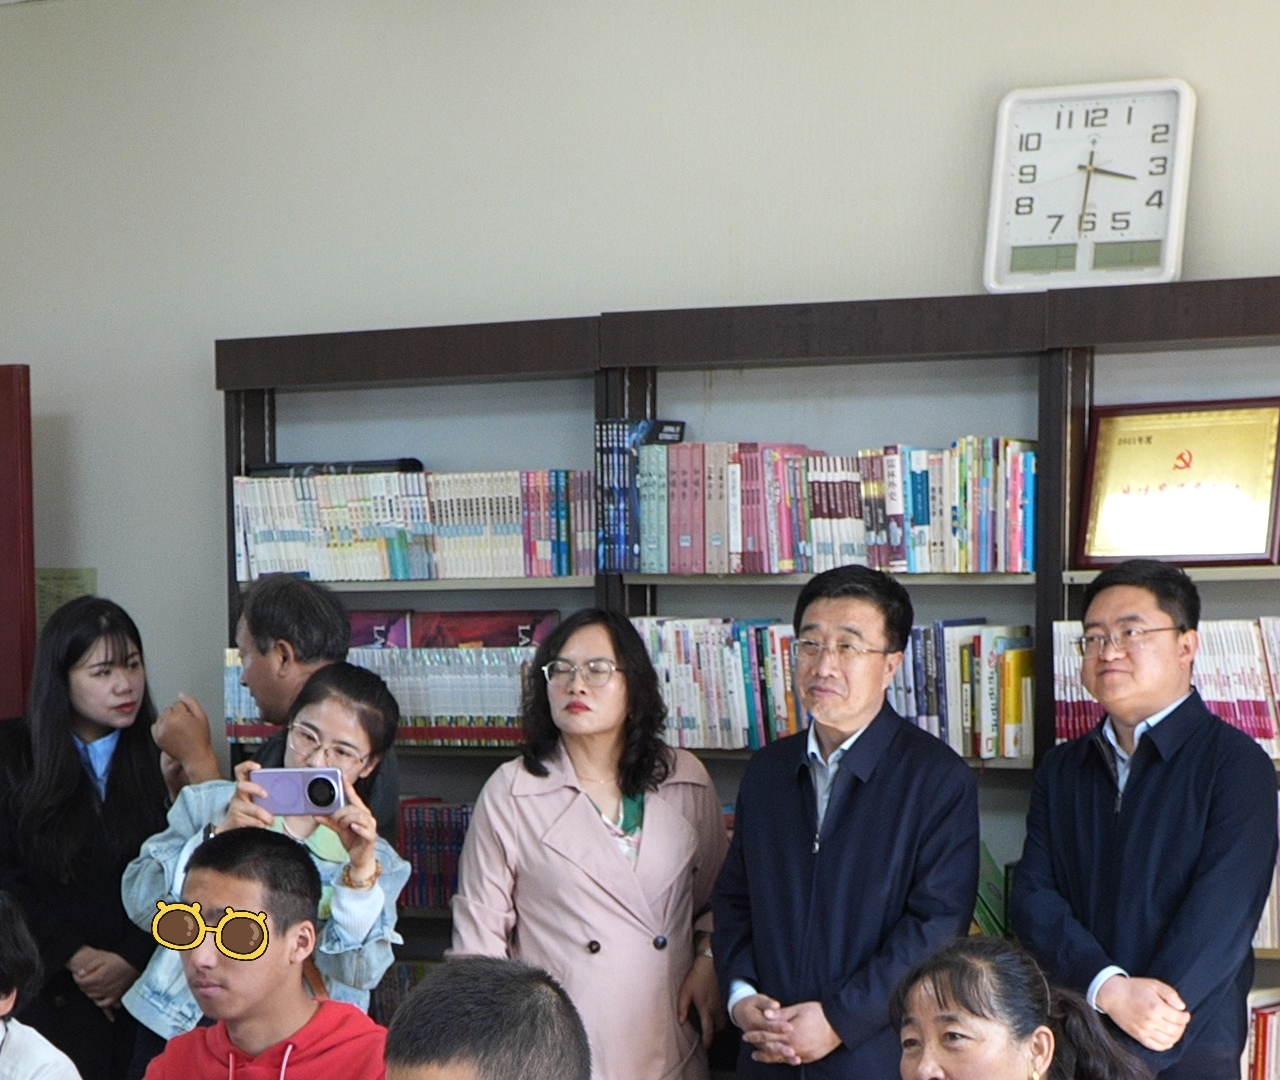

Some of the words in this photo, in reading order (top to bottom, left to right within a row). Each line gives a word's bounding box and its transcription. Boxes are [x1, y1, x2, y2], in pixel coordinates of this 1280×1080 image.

[1056, 110, 1073, 130] 11
[1084, 108, 1108, 128] 12
[1019, 132, 1042, 152] 10
[1151, 124, 1170, 144] 2
[1018, 164, 1037, 184] 9
[1148, 156, 1168, 176] 3
[1015, 196, 1034, 216] 8
[1145, 190, 1164, 209] 4
[1046, 214, 1064, 234] 7
[1078, 212, 1097, 232] 6
[1111, 211, 1131, 231] 5
